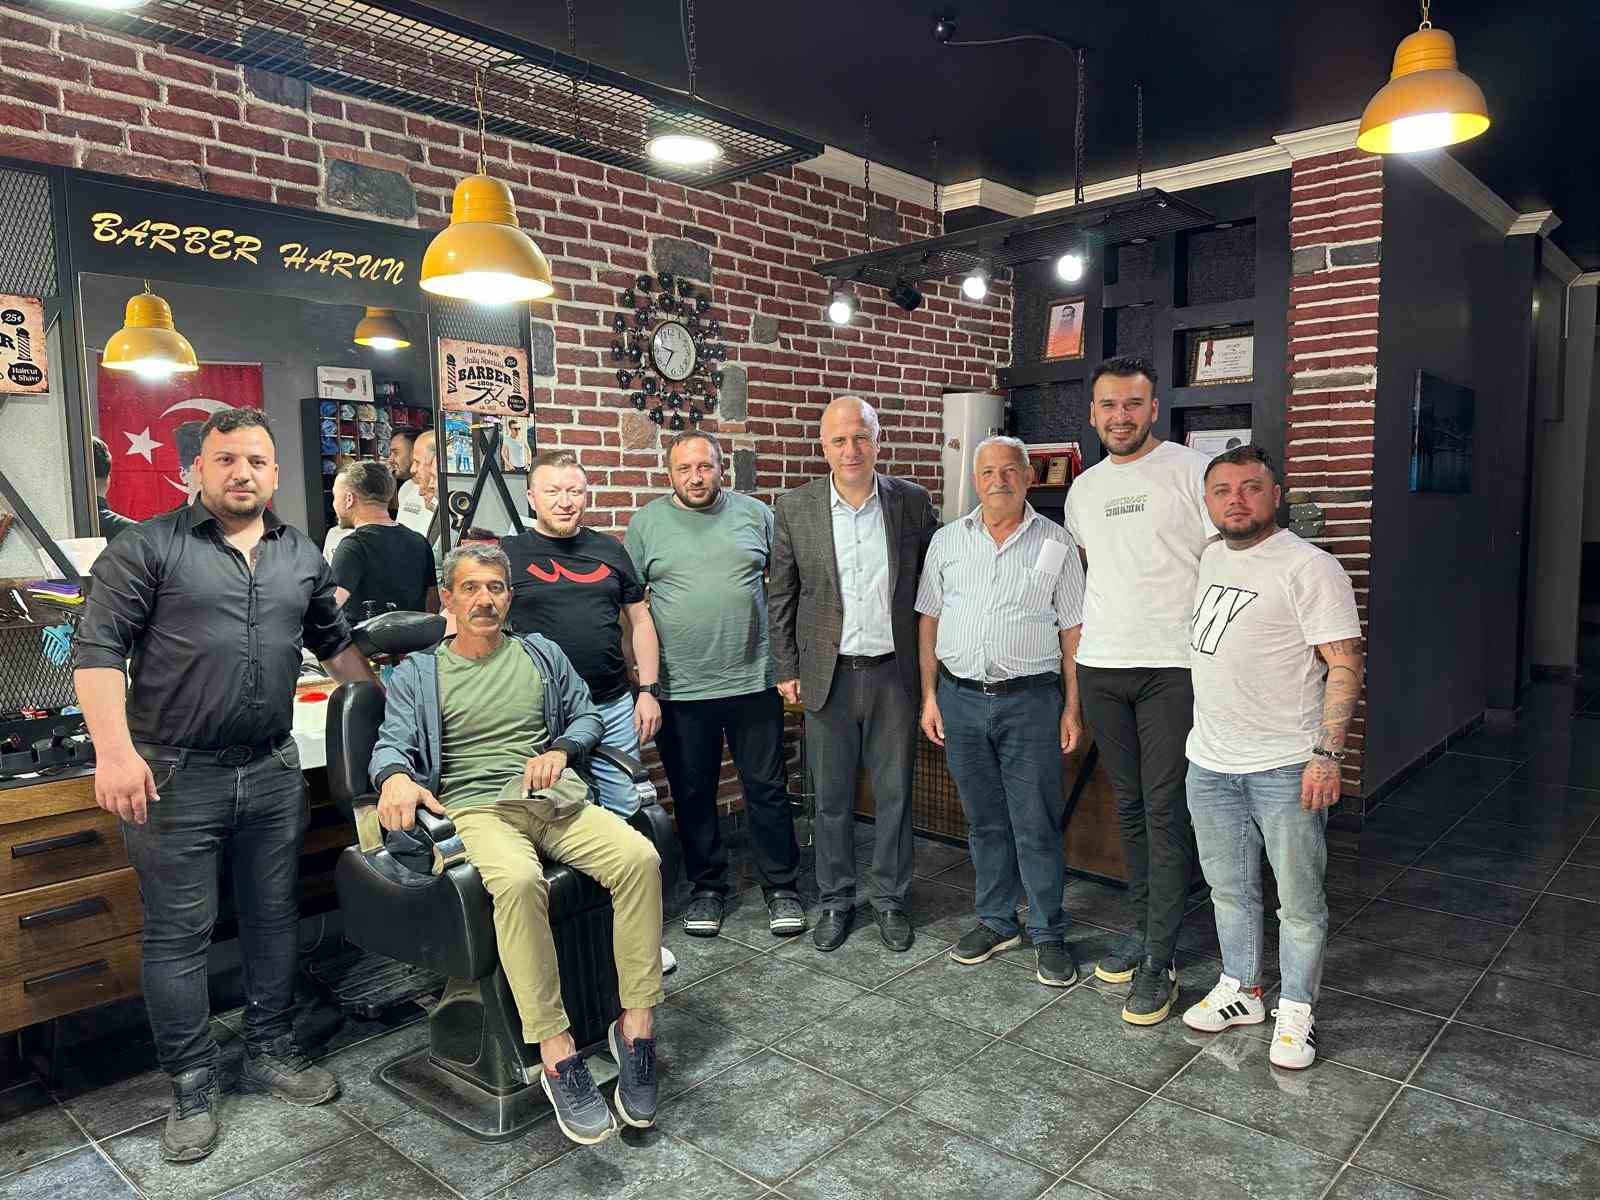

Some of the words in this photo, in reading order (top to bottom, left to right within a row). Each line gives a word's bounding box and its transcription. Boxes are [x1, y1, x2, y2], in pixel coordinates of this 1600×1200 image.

[91, 211, 262, 265] BARBER
[279, 243, 405, 285] HARUN
[464, 356, 480, 366] Daily
[12, 367, 38, 375] Haircut
[458, 366, 512, 385] BARBER
[18, 374, 40, 382] Shave
